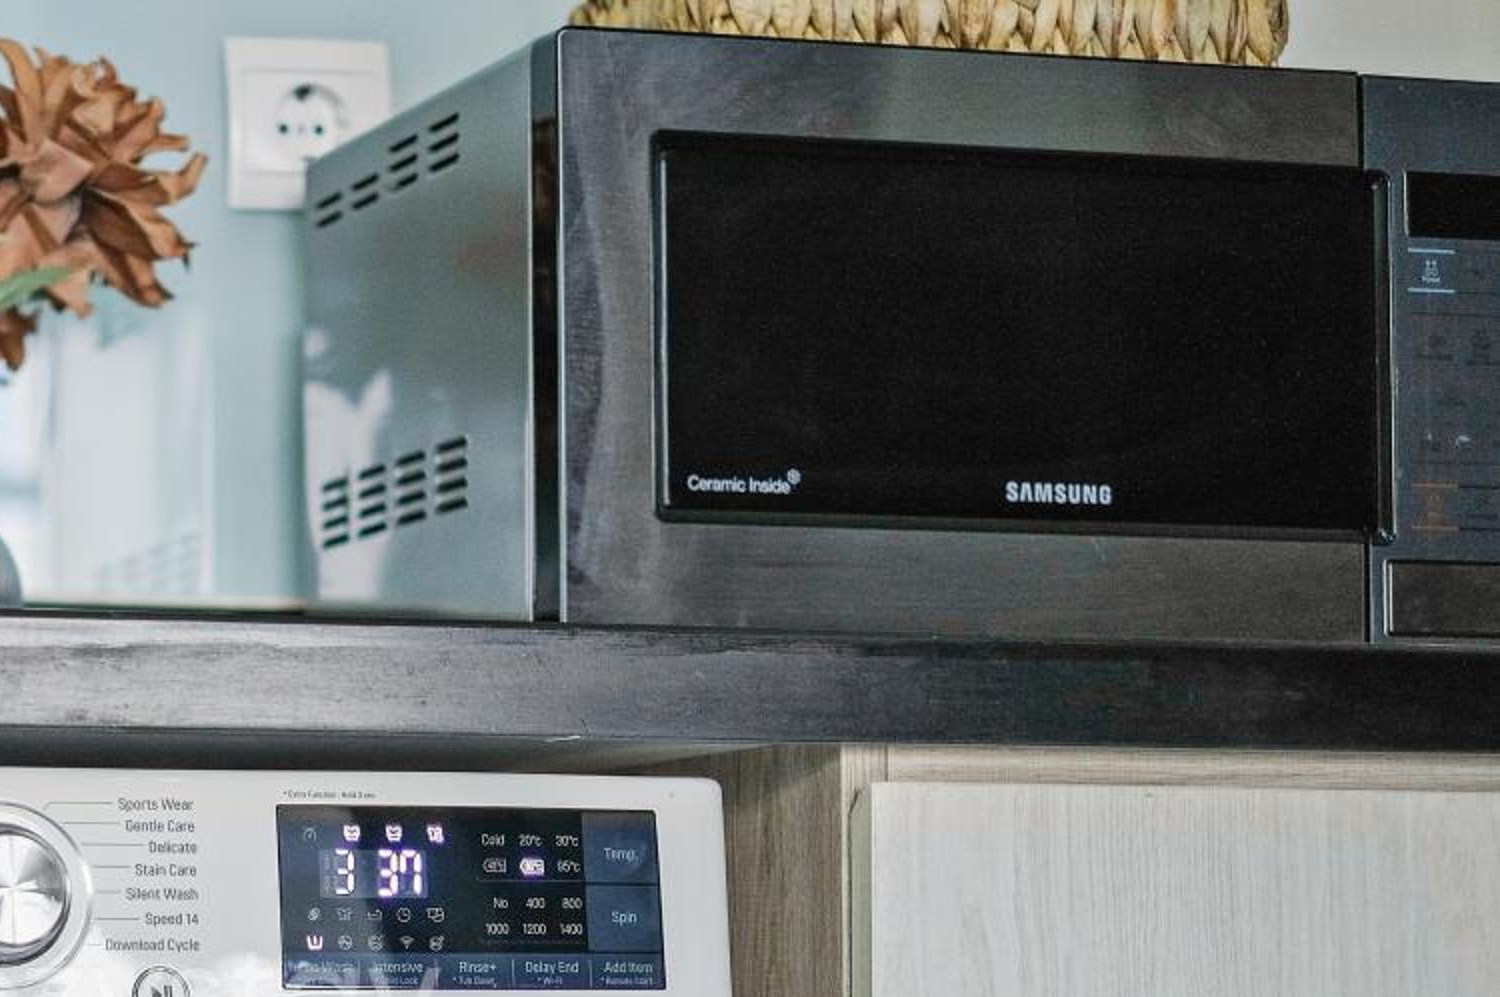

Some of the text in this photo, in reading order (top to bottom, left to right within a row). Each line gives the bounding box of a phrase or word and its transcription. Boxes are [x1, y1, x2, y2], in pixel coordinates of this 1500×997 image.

[687, 474, 747, 493] Ceramic
[1005, 480, 1112, 505] SAMSUNG
[117, 797, 195, 812] Sports Wear
[124, 819, 195, 832] Gentle Care
[148, 840, 197, 854] Delicate
[481, 833, 505, 847] Cold
[134, 863, 197, 876] Stain Care
[125, 887, 199, 901] Silent Wash
[145, 912, 199, 927] Speed 14
[611, 911, 637, 925] Spin
[523, 923, 547, 935] 1200
[105, 938, 200, 953] Download Cycle
[525, 961, 580, 974] Delay End
[603, 961, 627, 973] Add
